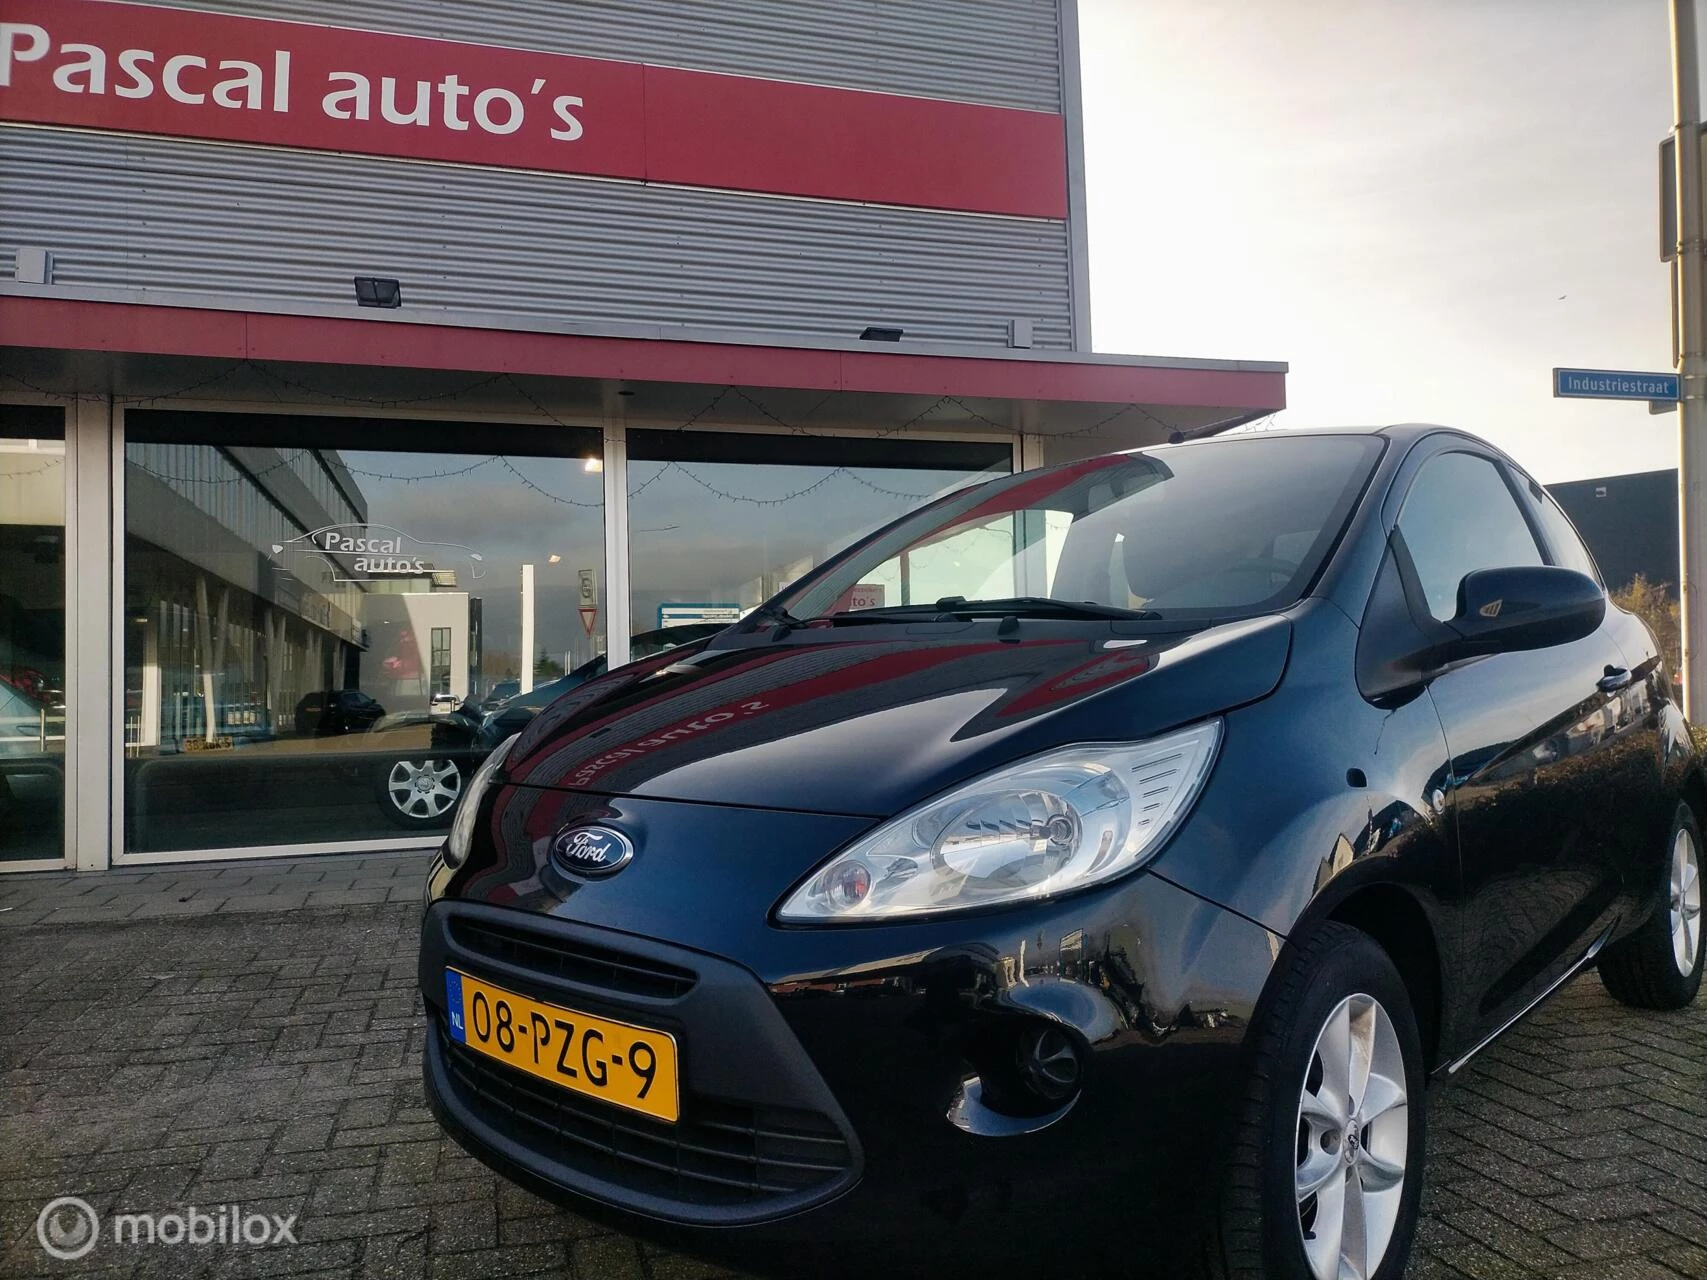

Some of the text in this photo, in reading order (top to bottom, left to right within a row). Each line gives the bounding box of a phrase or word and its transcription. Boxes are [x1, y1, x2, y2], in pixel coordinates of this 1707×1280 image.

[0, 22, 585, 142] Pascal auto's
[1568, 376, 1669, 394] Industriestraat
[325, 532, 402, 554] Pascal
[353, 556, 425, 575] auto's
[566, 832, 612, 862] Ford
[452, 1011, 464, 1030] NL
[472, 991, 657, 1100] 08-PZG-9
